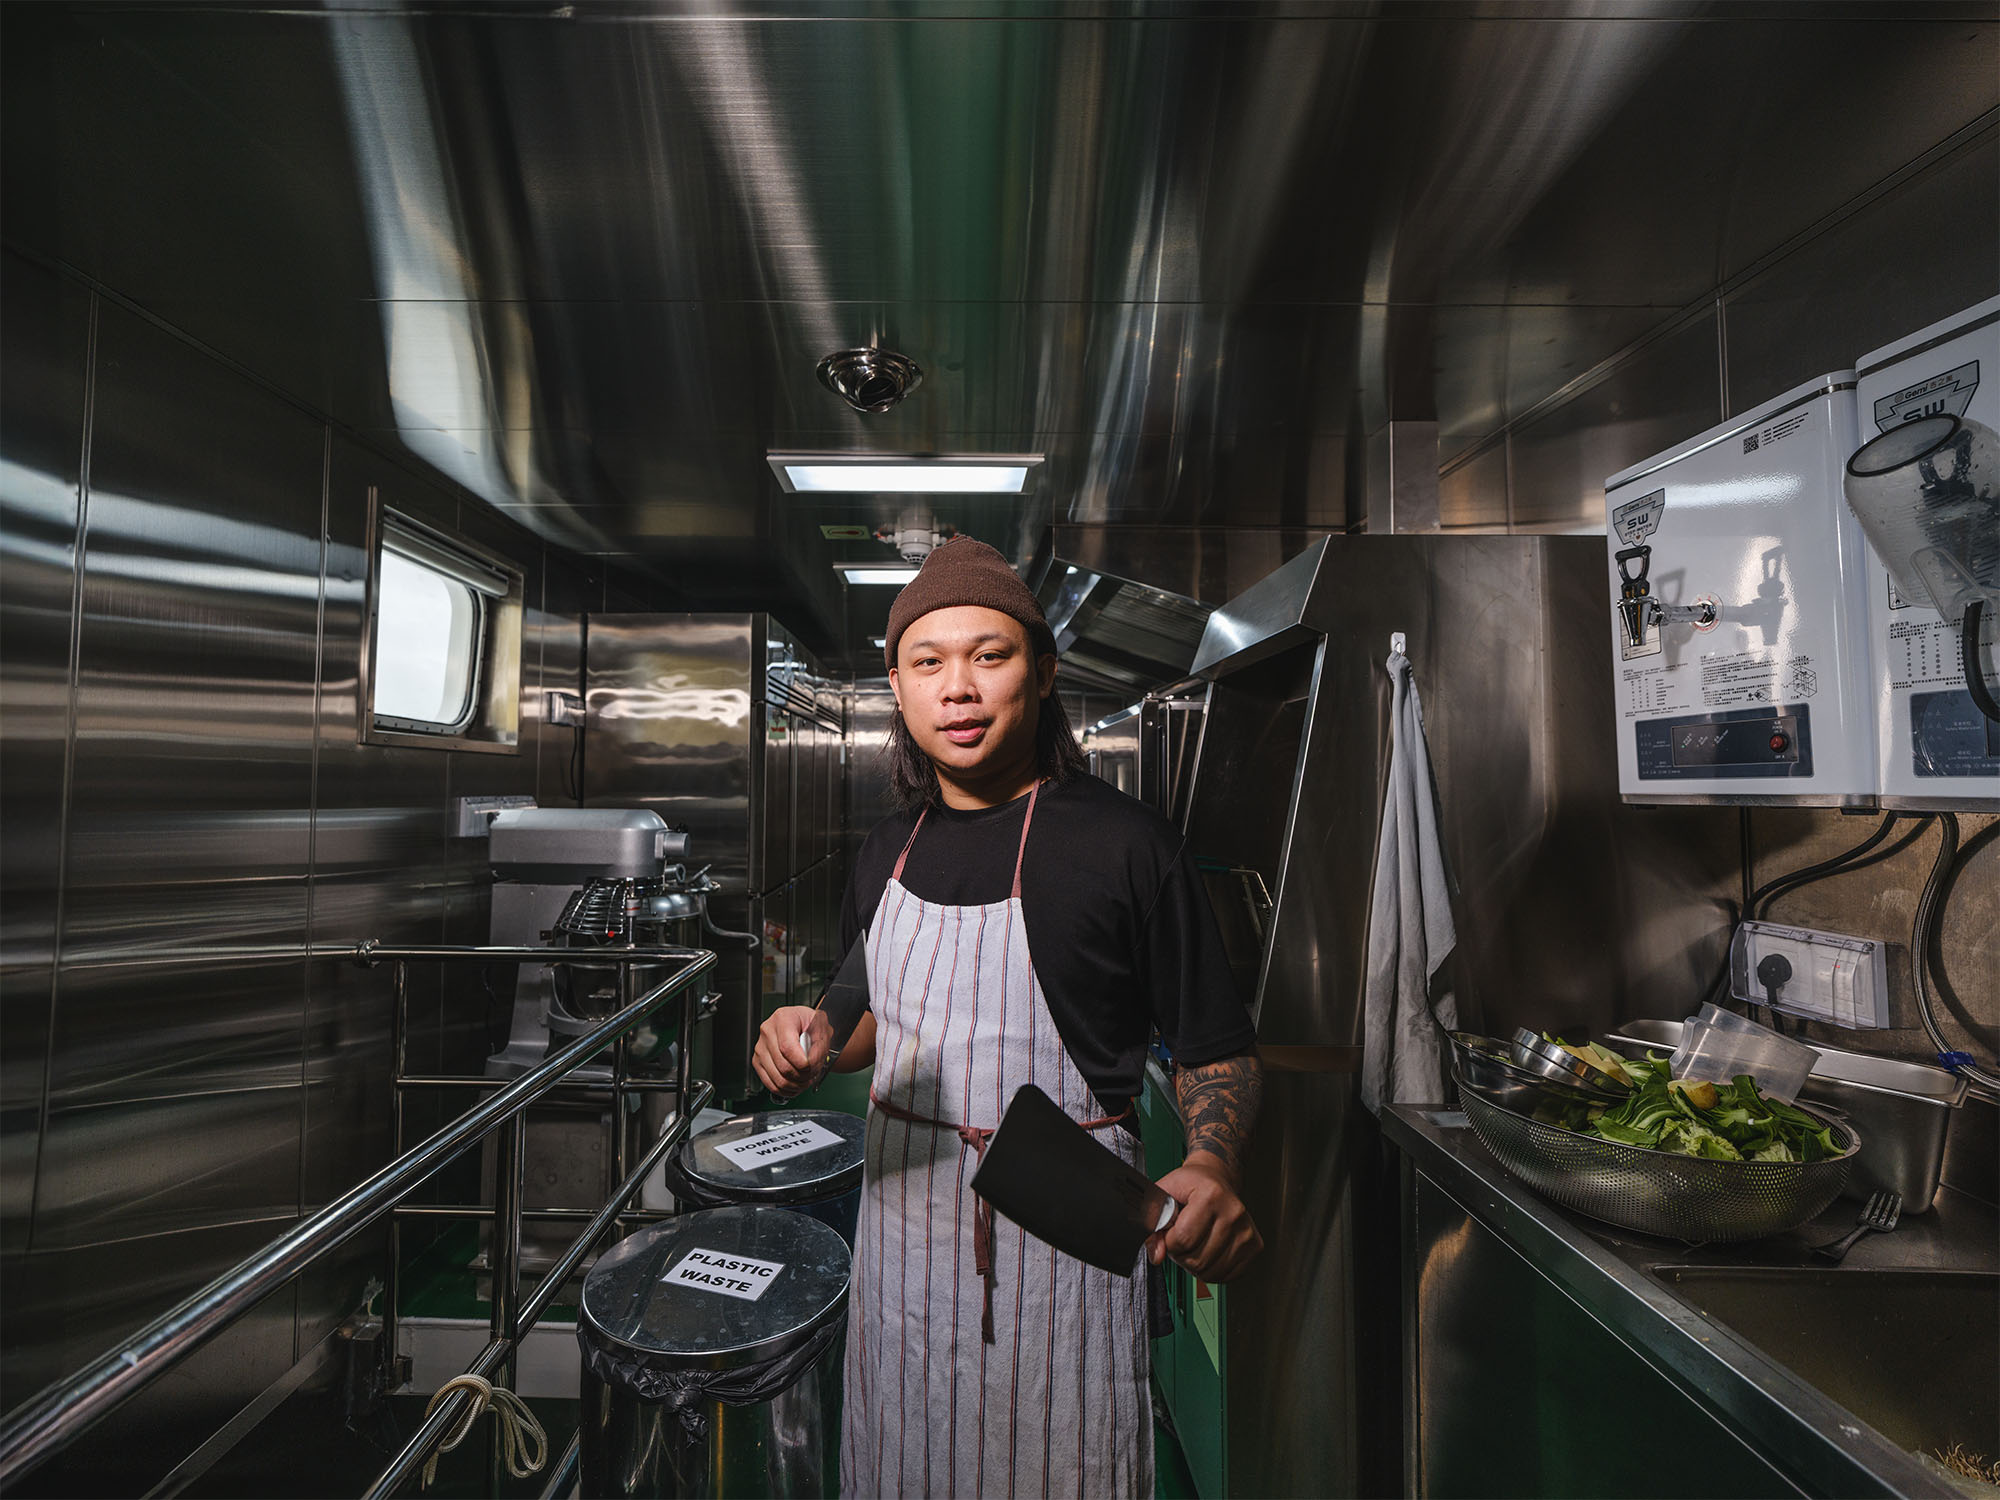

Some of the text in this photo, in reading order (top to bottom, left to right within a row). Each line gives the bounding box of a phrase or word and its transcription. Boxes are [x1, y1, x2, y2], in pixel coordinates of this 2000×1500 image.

[1905, 383, 1928, 399] Gemi
[1627, 512, 1649, 530] SW
[734, 1128, 813, 1154] DOMESTIC
[756, 1137, 812, 1156] WASTE
[688, 1253, 774, 1278] PLASTIC
[679, 1268, 753, 1292] WASTE
